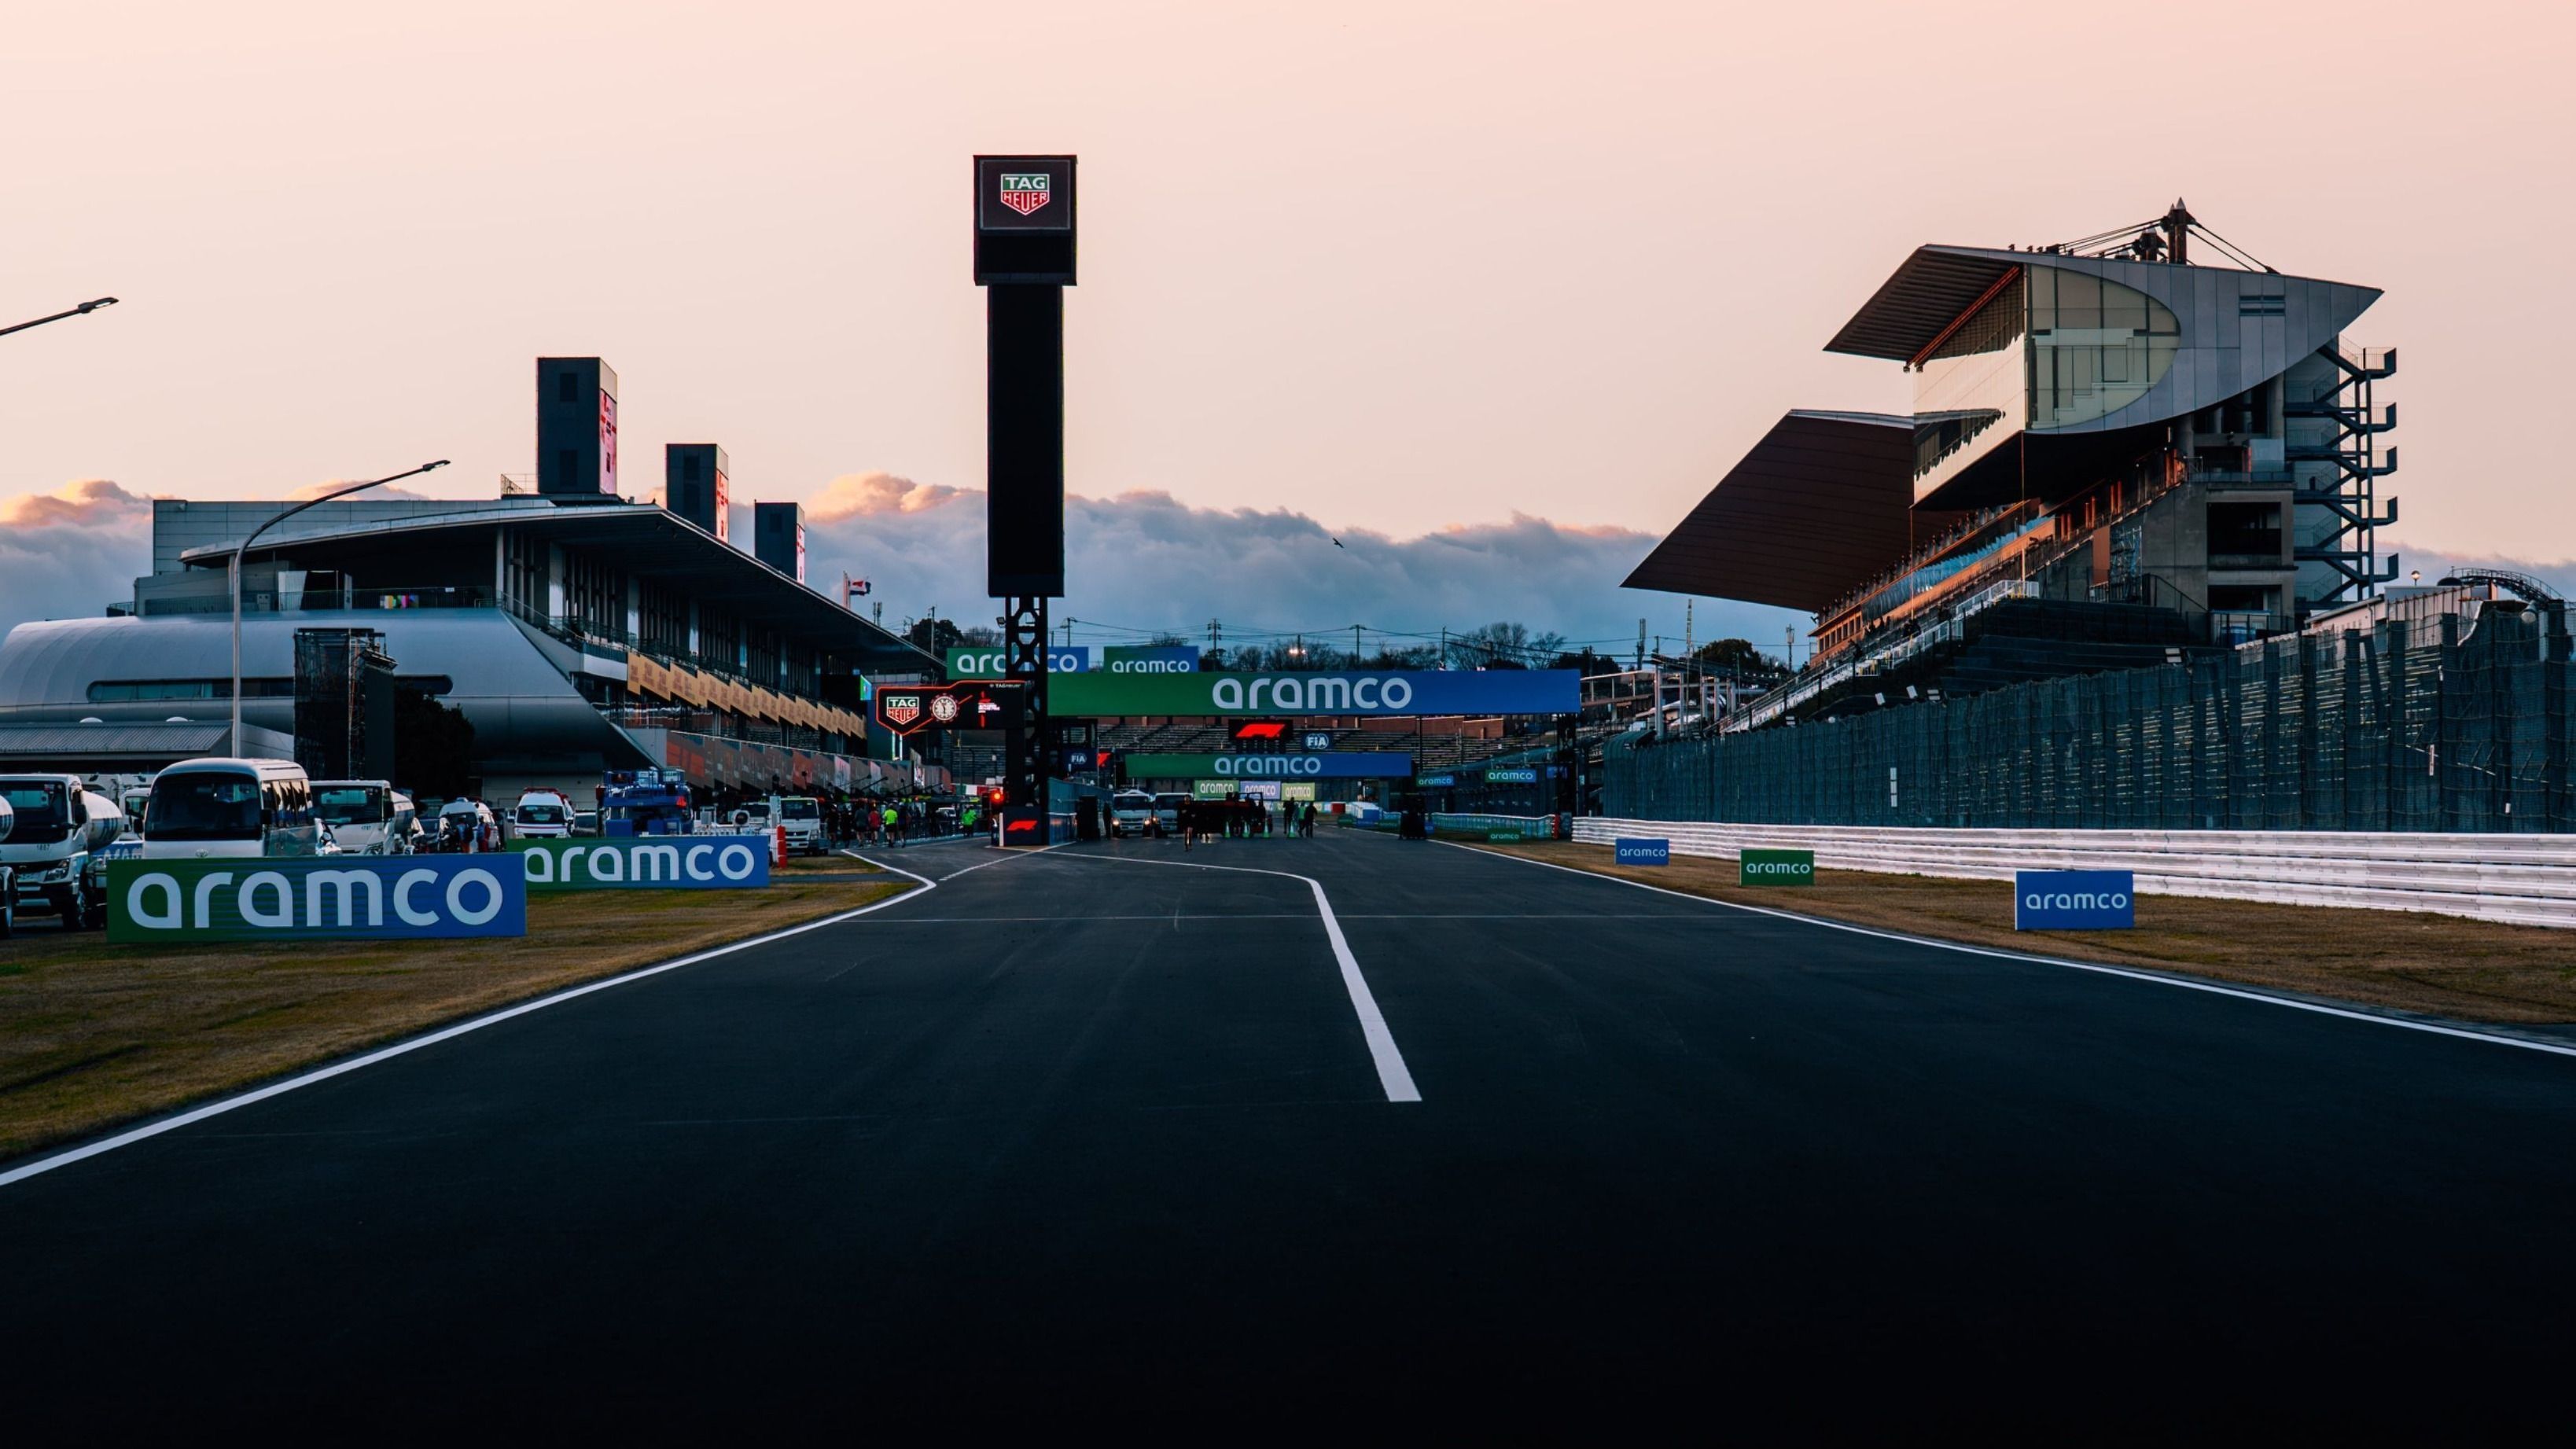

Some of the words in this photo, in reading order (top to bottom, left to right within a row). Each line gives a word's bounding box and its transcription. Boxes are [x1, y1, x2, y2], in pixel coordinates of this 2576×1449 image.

[1005, 177, 1045, 189] TAG
[1004, 193, 1047, 211] HEUER
[1112, 660, 1190, 673] aramco
[1213, 678, 1412, 709] aramco
[889, 708, 918, 721] HEUER
[1215, 756, 1321, 774] aramco
[1489, 771, 1533, 780] aramco
[1200, 781, 1234, 793] aramco
[1285, 786, 1311, 797] aramco
[1620, 847, 1667, 857] aramco
[525, 844, 755, 882] aramco
[1746, 861, 1810, 874] aramco
[127, 868, 503, 929] aramco
[2026, 892, 2127, 910] aramco
